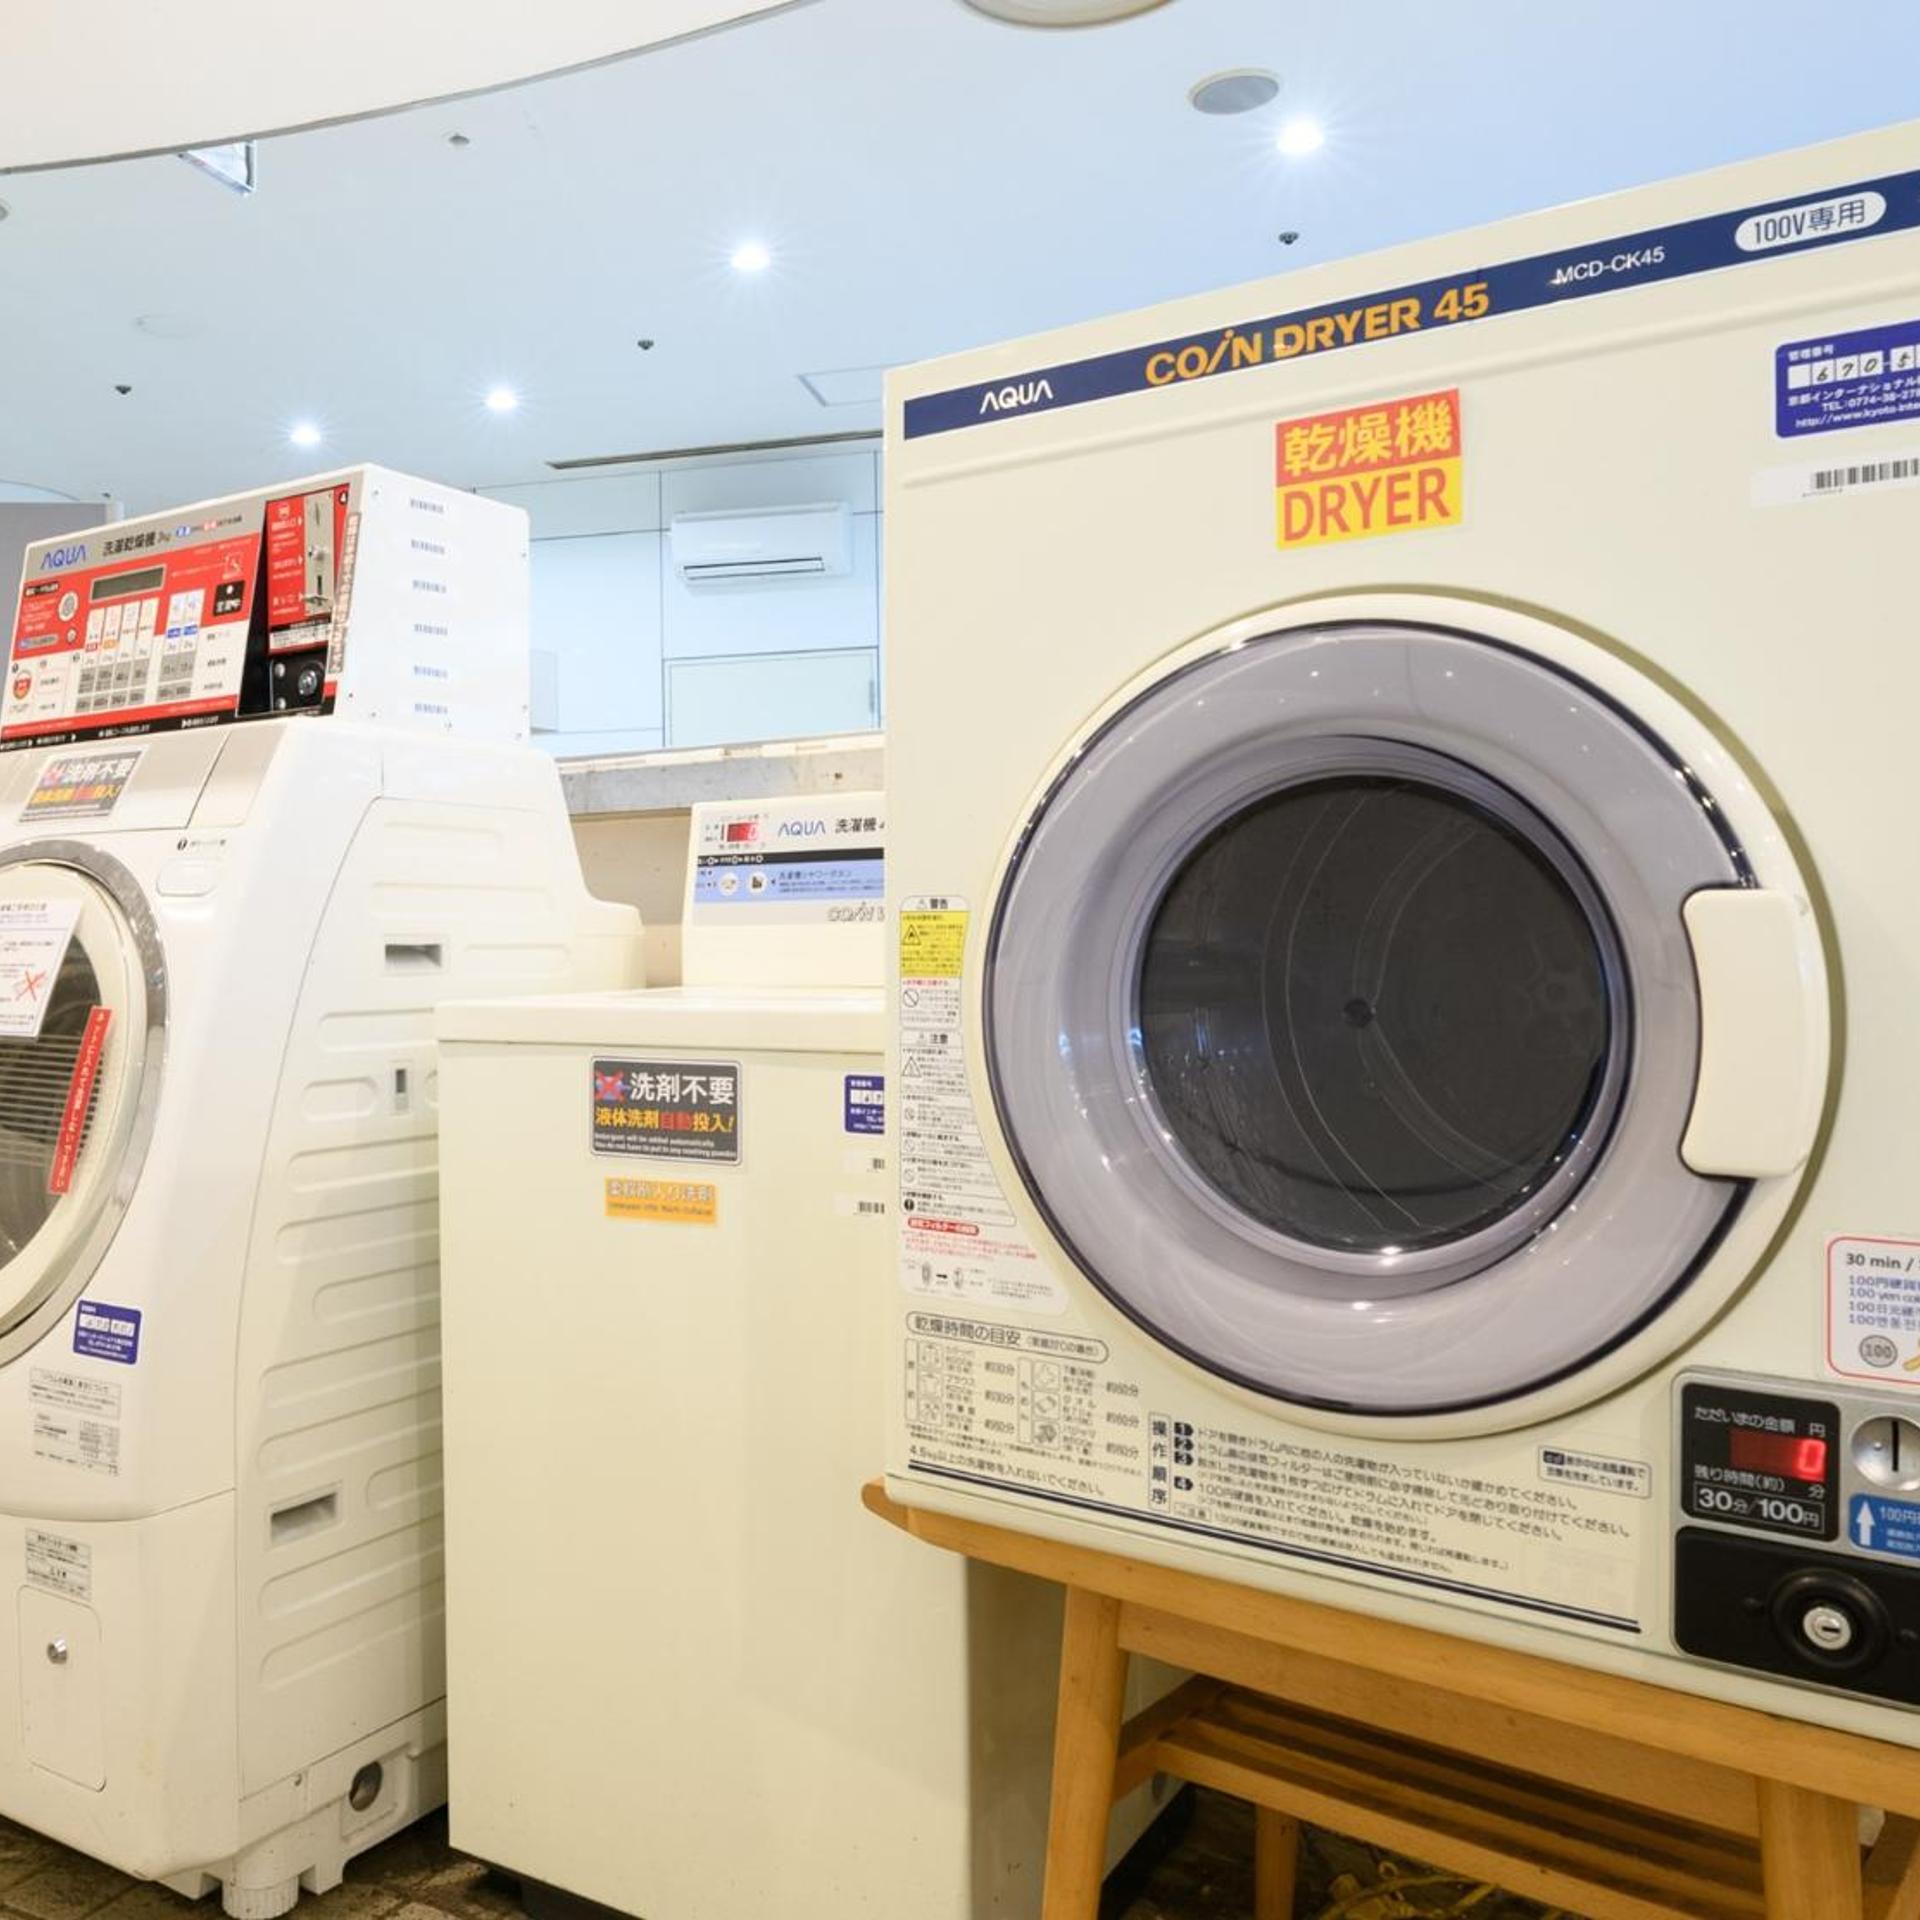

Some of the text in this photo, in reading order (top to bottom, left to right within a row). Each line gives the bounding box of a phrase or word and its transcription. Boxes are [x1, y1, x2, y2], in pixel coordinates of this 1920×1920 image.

[1754, 199, 1865, 245] 100V専用
[980, 379, 1053, 414] AQUA
[1273, 298, 1421, 360] DRYER
[1434, 282, 1489, 322] 45
[1554, 246, 1665, 284] MCD-CK45
[1284, 400, 1452, 476] 乾燥機
[1284, 467, 1450, 541] DRYER
[41, 544, 86, 571] AQUA
[778, 817, 877, 837] AQUA 洗濯機
[630, 1072, 735, 1105] 洗剤不要
[1846, 1253, 1865, 1266] 30
[1870, 1255, 1901, 1269] min
[1849, 1287, 1875, 1298] 100
[1879, 1292, 1900, 1302] yen
[914, 1316, 1022, 1346] 乾燥時間の目安
[1865, 1343, 1892, 1358] 100
[1694, 1406, 1825, 1437] ただいまの金額 円
[1152, 1420, 1168, 1505] 操作順序
[1798, 1438, 1826, 1473] 0
[1694, 1464, 1825, 1499] 残り時間(約) 分
